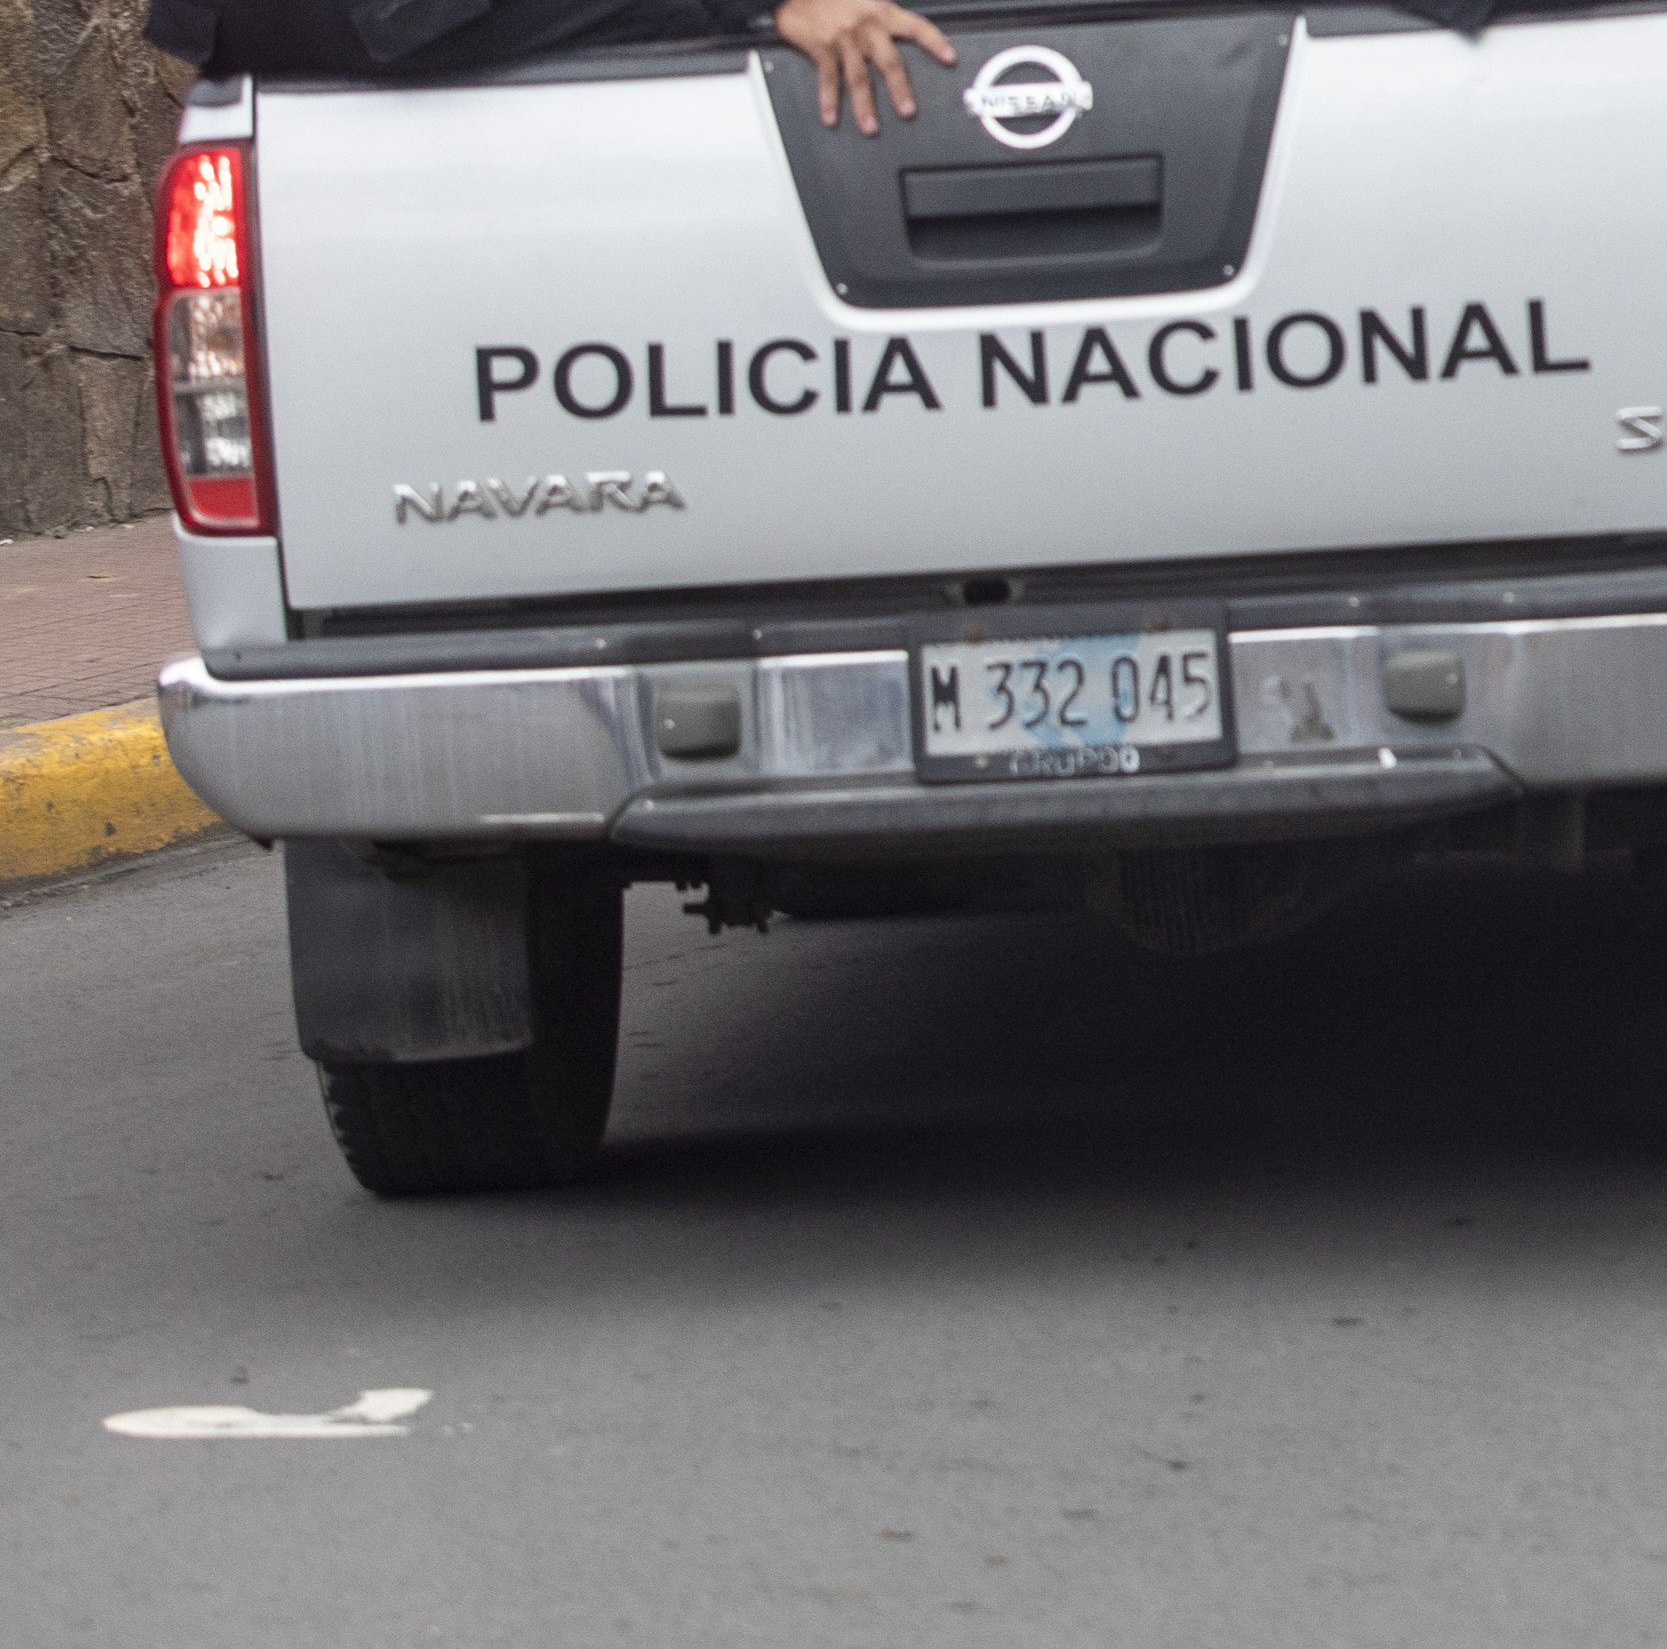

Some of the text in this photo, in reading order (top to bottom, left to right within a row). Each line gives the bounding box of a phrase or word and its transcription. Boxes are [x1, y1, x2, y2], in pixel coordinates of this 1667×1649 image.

[475, 298, 1591, 422] POLICIA NACIONAL
[394, 470, 687, 525] NAVARA
[931, 652, 1213, 732] M 332 045
